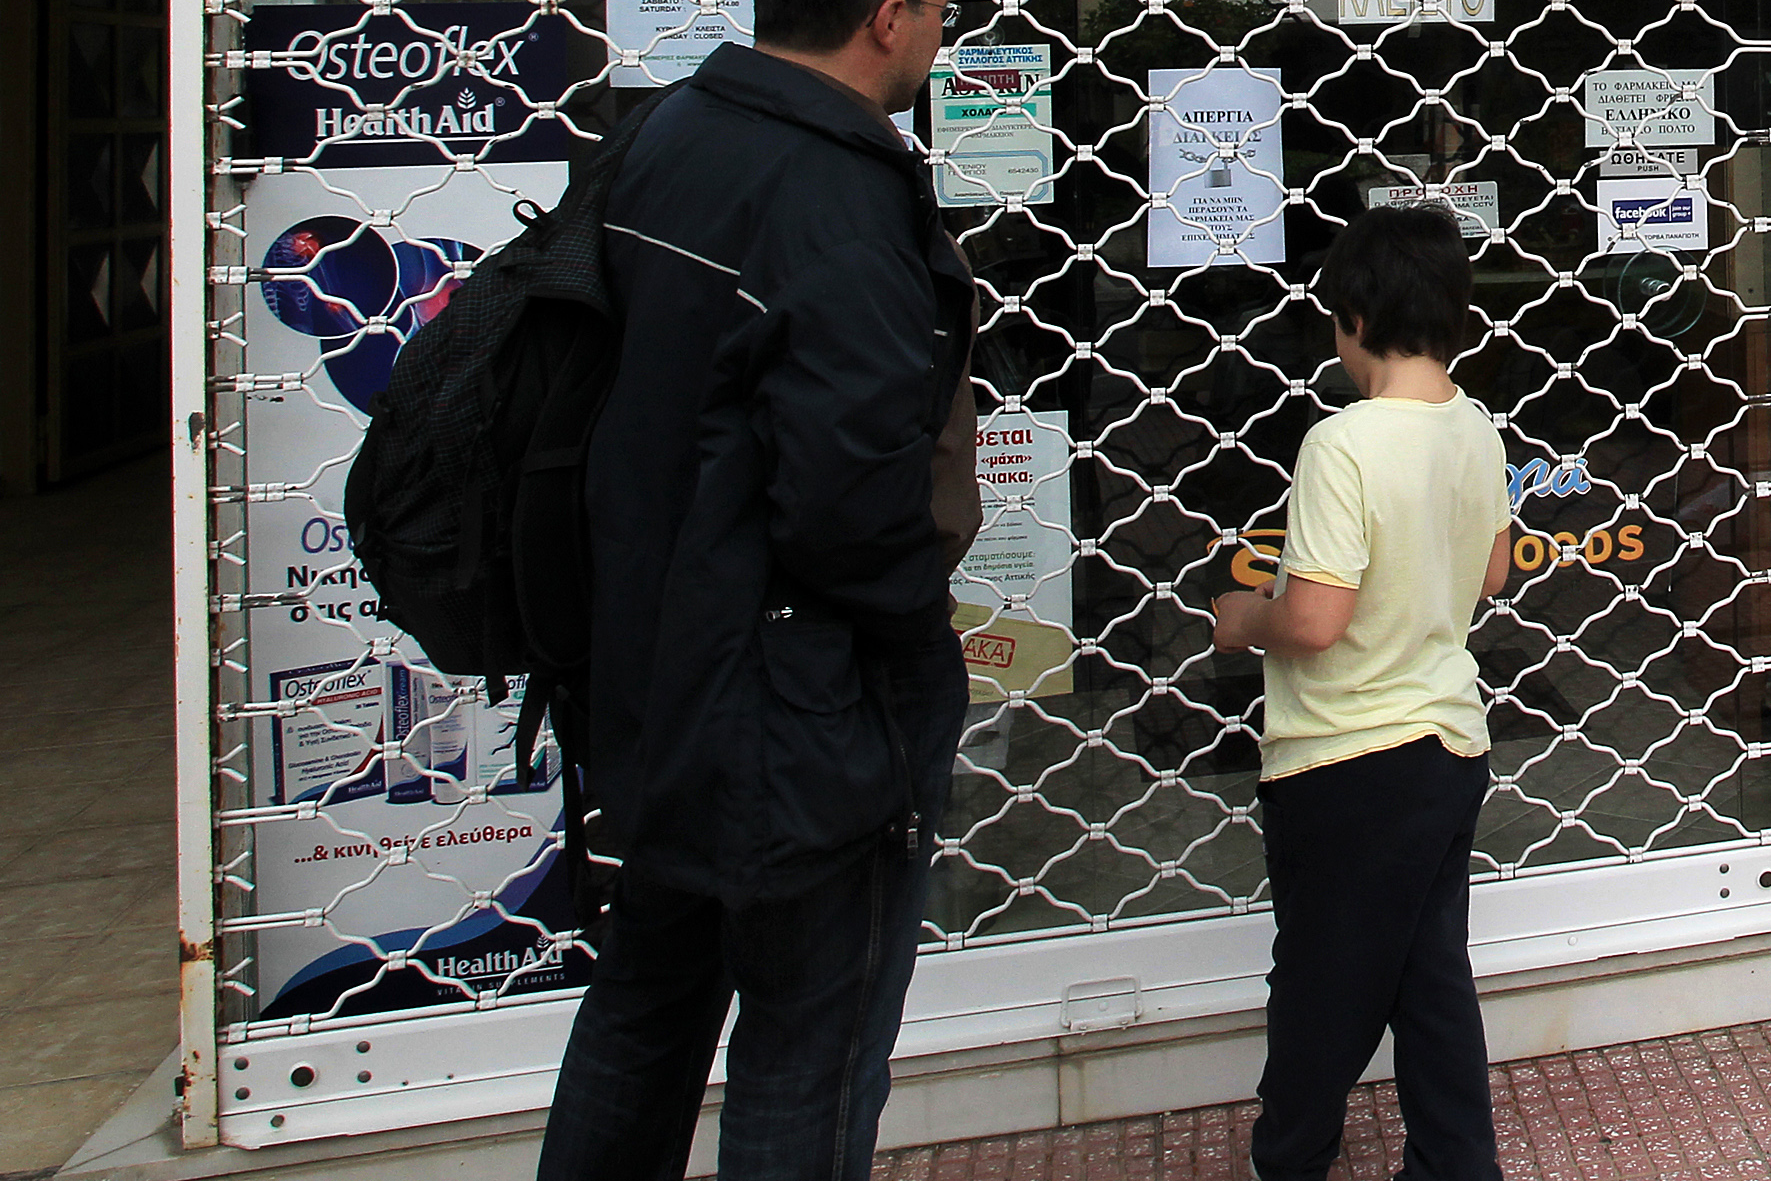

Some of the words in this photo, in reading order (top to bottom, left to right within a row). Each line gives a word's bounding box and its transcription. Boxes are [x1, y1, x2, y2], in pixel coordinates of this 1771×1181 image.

[1593, 83, 1607, 91] ΤΟ
[1598, 94, 1646, 104] ΔΙΑΘΕΤΕΙ
[1182, 111, 1254, 123] ΑΠΕΡΓΙΑ
[1388, 185, 1478, 198] ΠΡΟΟΧΗ
[436, 823, 533, 849] ελεύθερα
